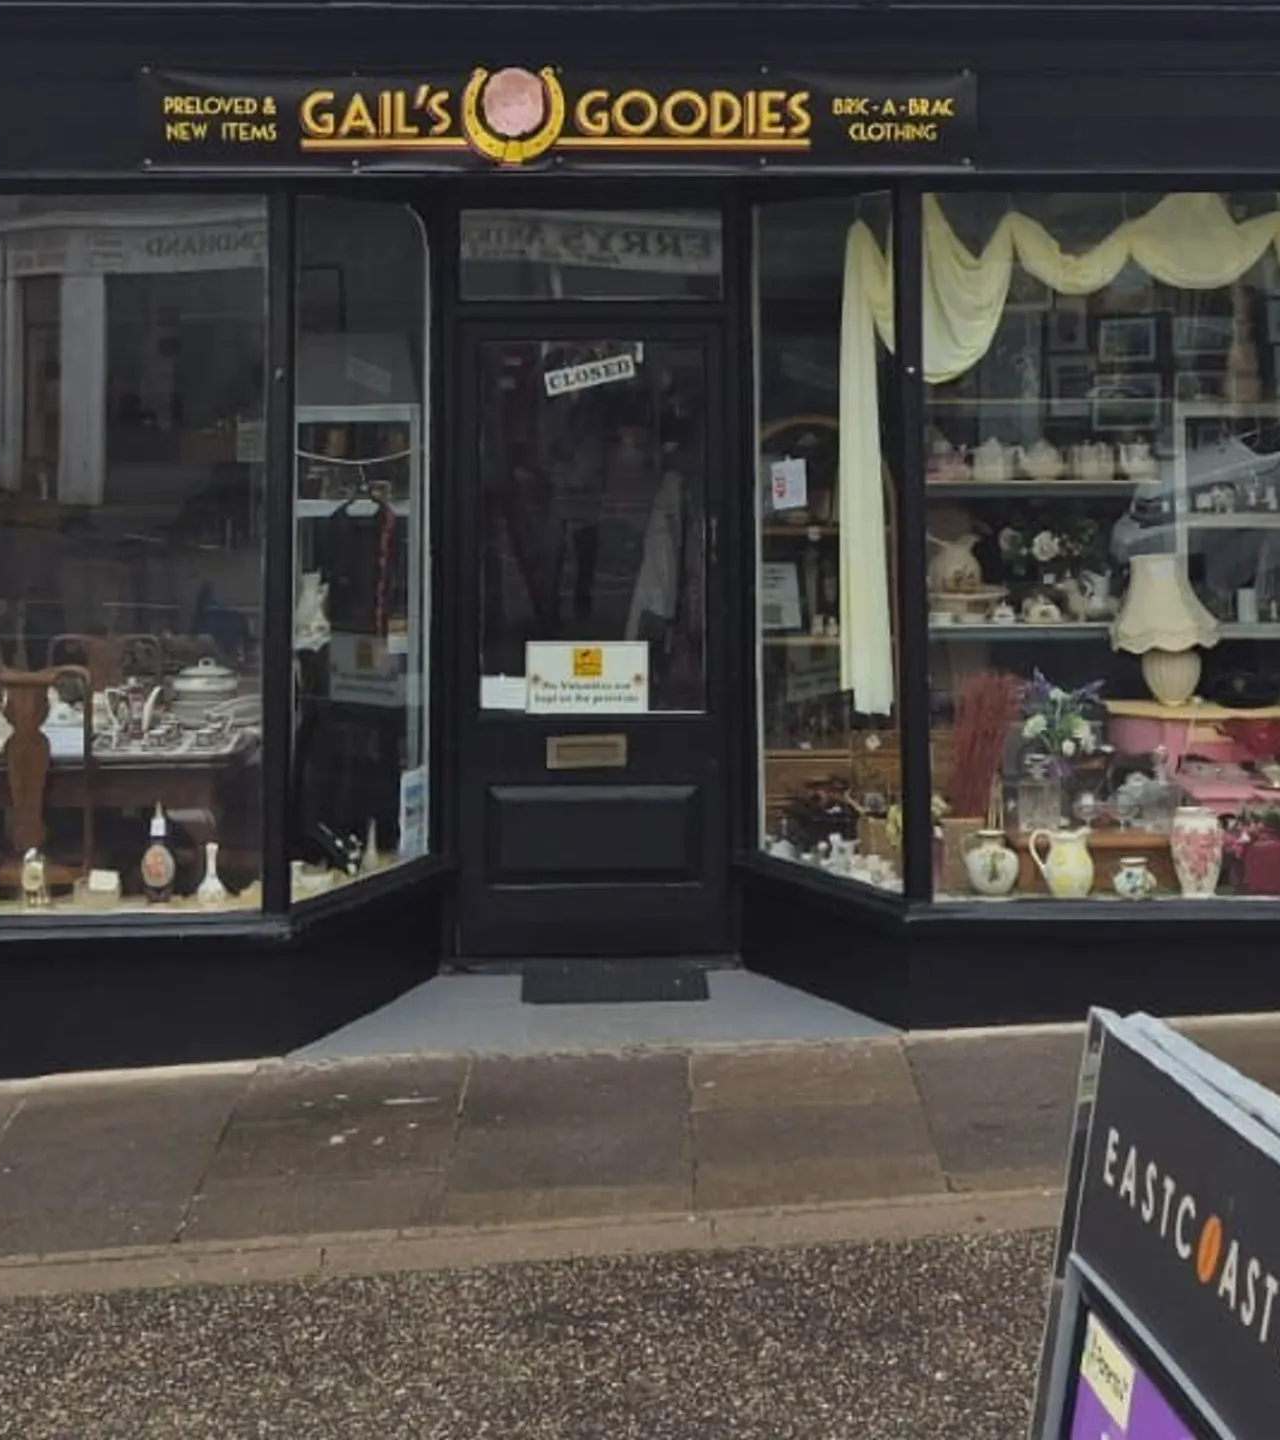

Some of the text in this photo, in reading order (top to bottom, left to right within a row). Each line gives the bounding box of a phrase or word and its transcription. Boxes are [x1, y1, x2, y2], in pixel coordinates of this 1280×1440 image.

[164, 95, 277, 115] PRELOVED &
[301, 84, 812, 137] GAIL'S GOODIES
[166, 122, 277, 141] NEW ITEMS
[848, 122, 938, 141] CLOTHING
[548, 359, 631, 389] CLOSED
